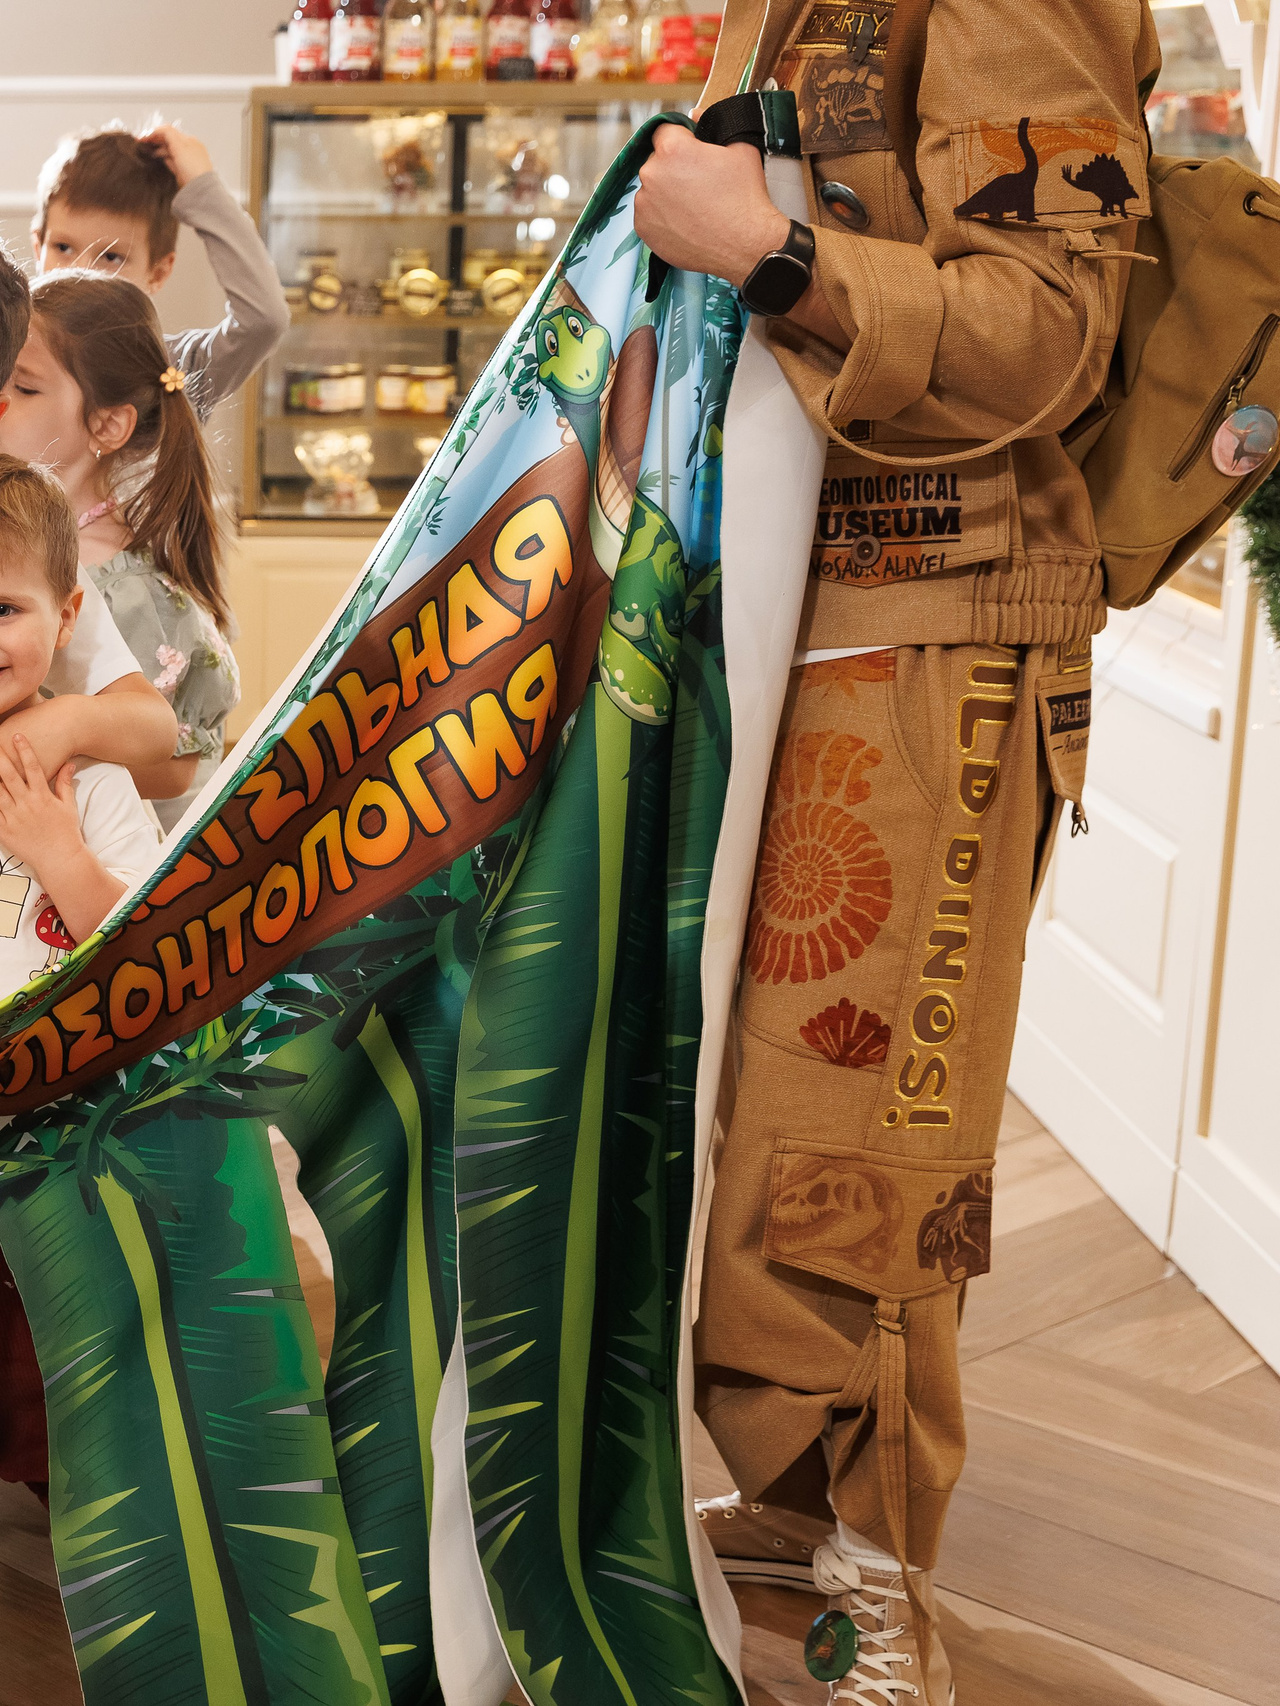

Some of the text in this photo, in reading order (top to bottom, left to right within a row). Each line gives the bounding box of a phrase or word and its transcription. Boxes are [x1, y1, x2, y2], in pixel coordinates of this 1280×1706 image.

[820, 473, 961, 506] EONTOLOGICAL
[816, 506, 962, 541] USEUM
[881, 660, 1018, 1130] ILD DINOS!
